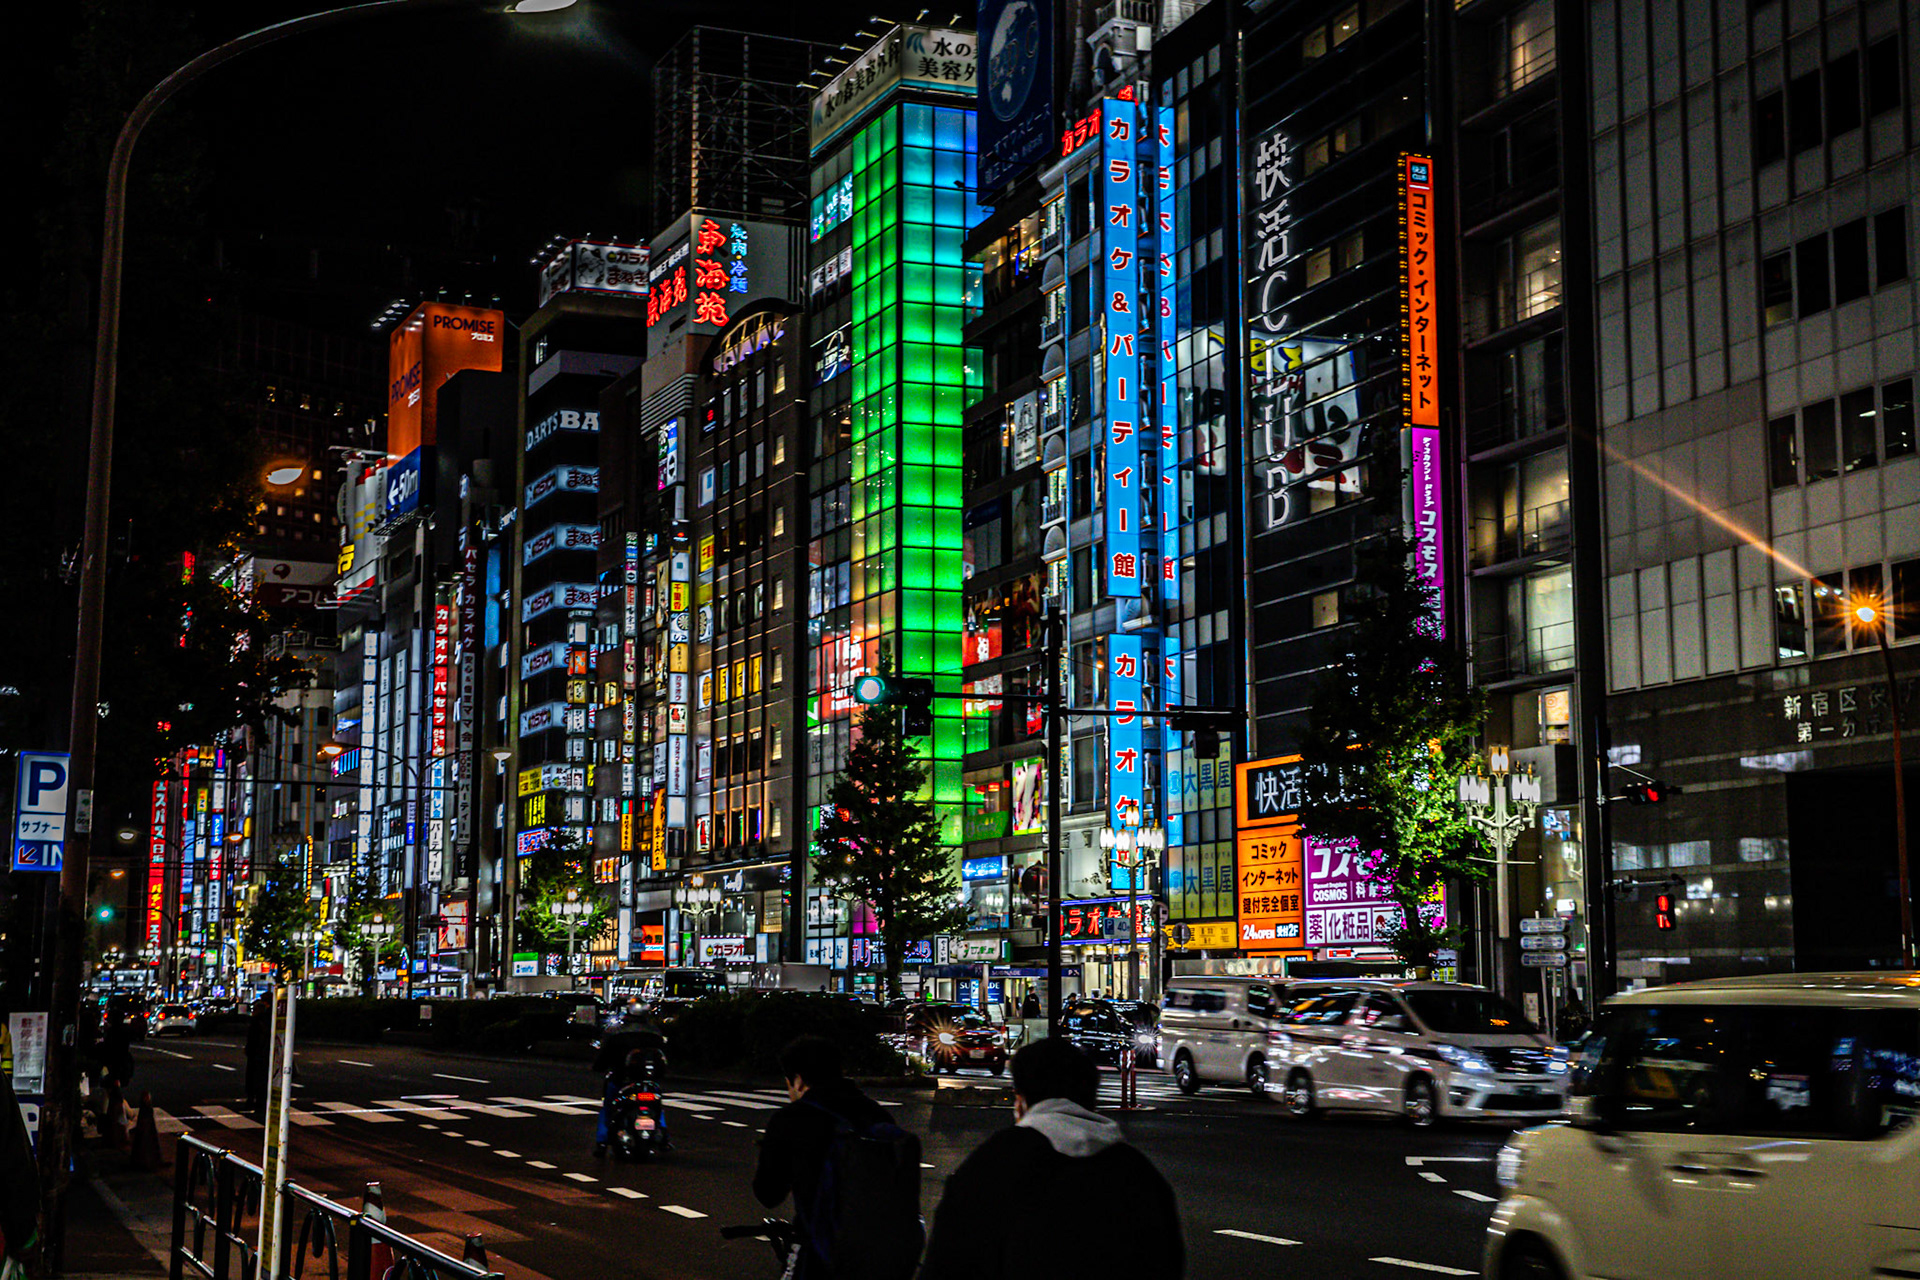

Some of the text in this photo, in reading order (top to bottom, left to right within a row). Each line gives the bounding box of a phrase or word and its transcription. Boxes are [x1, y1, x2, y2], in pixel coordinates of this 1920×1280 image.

[433, 315, 495, 334] PROMISE
[526, 411, 558, 451] DARTS
[399, 468, 419, 503] 50m
[1419, 510, 1437, 578] コスモス
[463, 548, 477, 648] パセラ カラオケ
[435, 609, 448, 664] カラオケ
[433, 681, 447, 724] パセラ
[1115, 653, 1139, 868] カラオケ
[28, 761, 66, 806] P
[1184, 761, 1233, 794] 大黒屋
[21, 821, 60, 834] サブナー
[42, 844, 63, 866] IN
[1251, 841, 1287, 860] コミック
[1185, 864, 1233, 897] 大黒屋
[1242, 867, 1299, 888] インターネット
[1243, 894, 1300, 914] 鍵付完全個室
[1313, 889, 1348, 902] COSMOS
[1309, 914, 1323, 940] 薬
[1328, 908, 1370, 941] 化粧品
[149, 924, 161, 963] エスス
